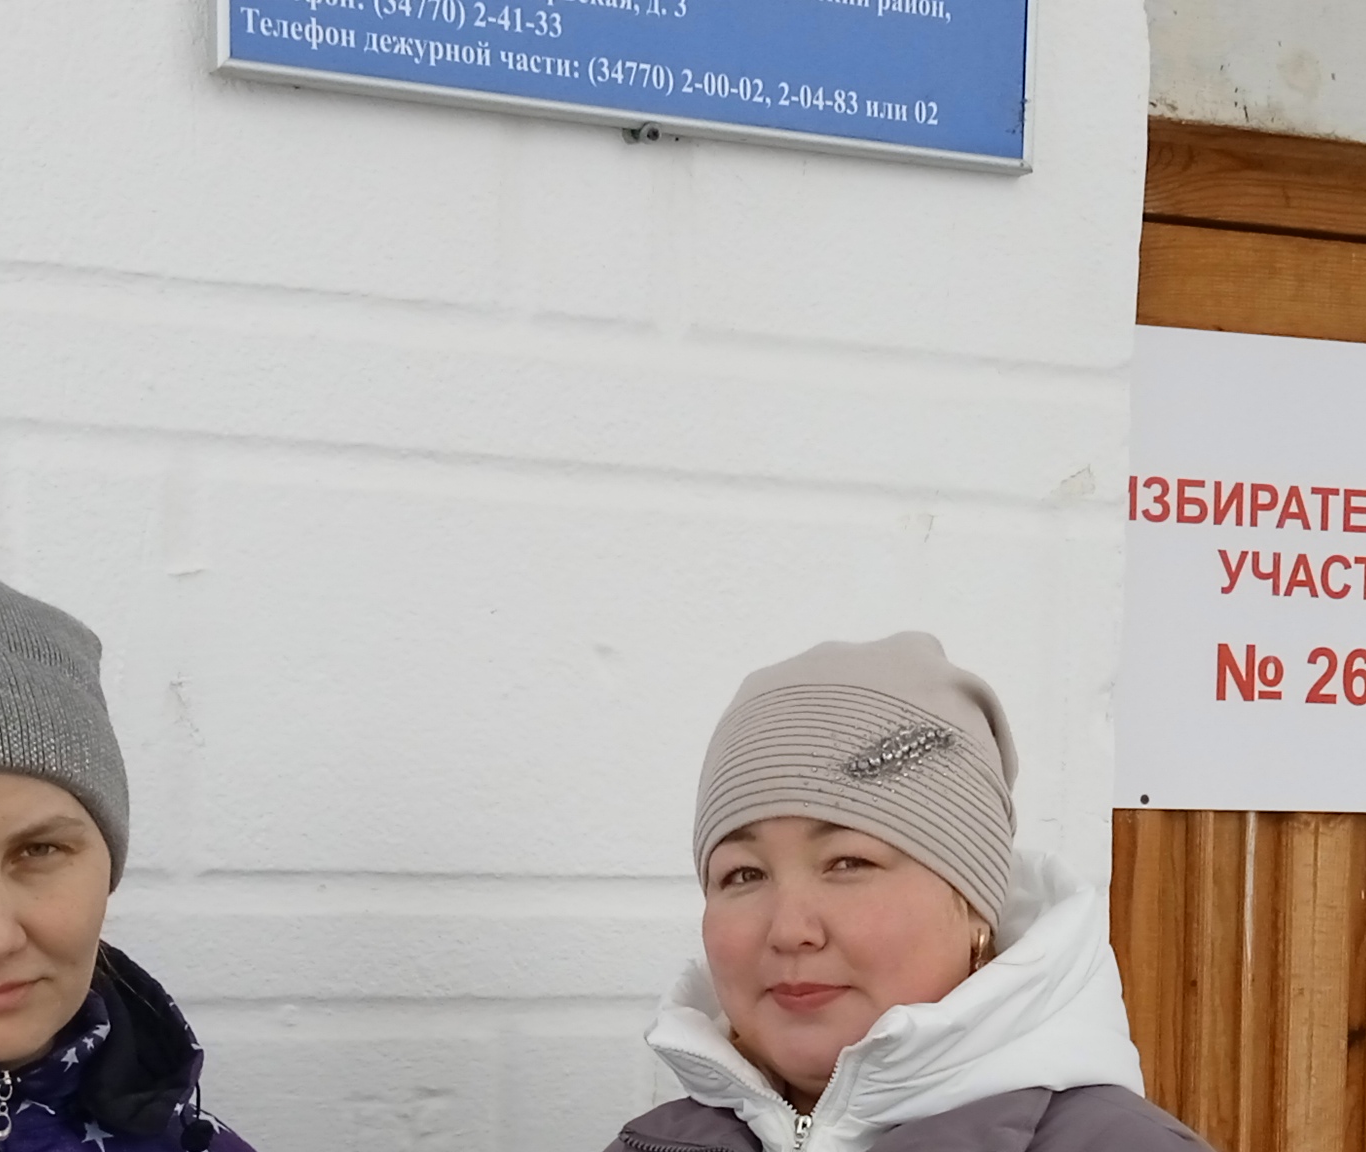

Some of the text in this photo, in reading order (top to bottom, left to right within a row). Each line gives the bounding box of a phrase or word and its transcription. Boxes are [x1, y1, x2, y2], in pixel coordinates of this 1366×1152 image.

[473, 2, 563, 38] 2-41-33
[240, 7, 939, 126] Телефон дежурной части: (34770) 2-00-02, 2-04-83 или 02
[1216, 643, 1284, 702] №
